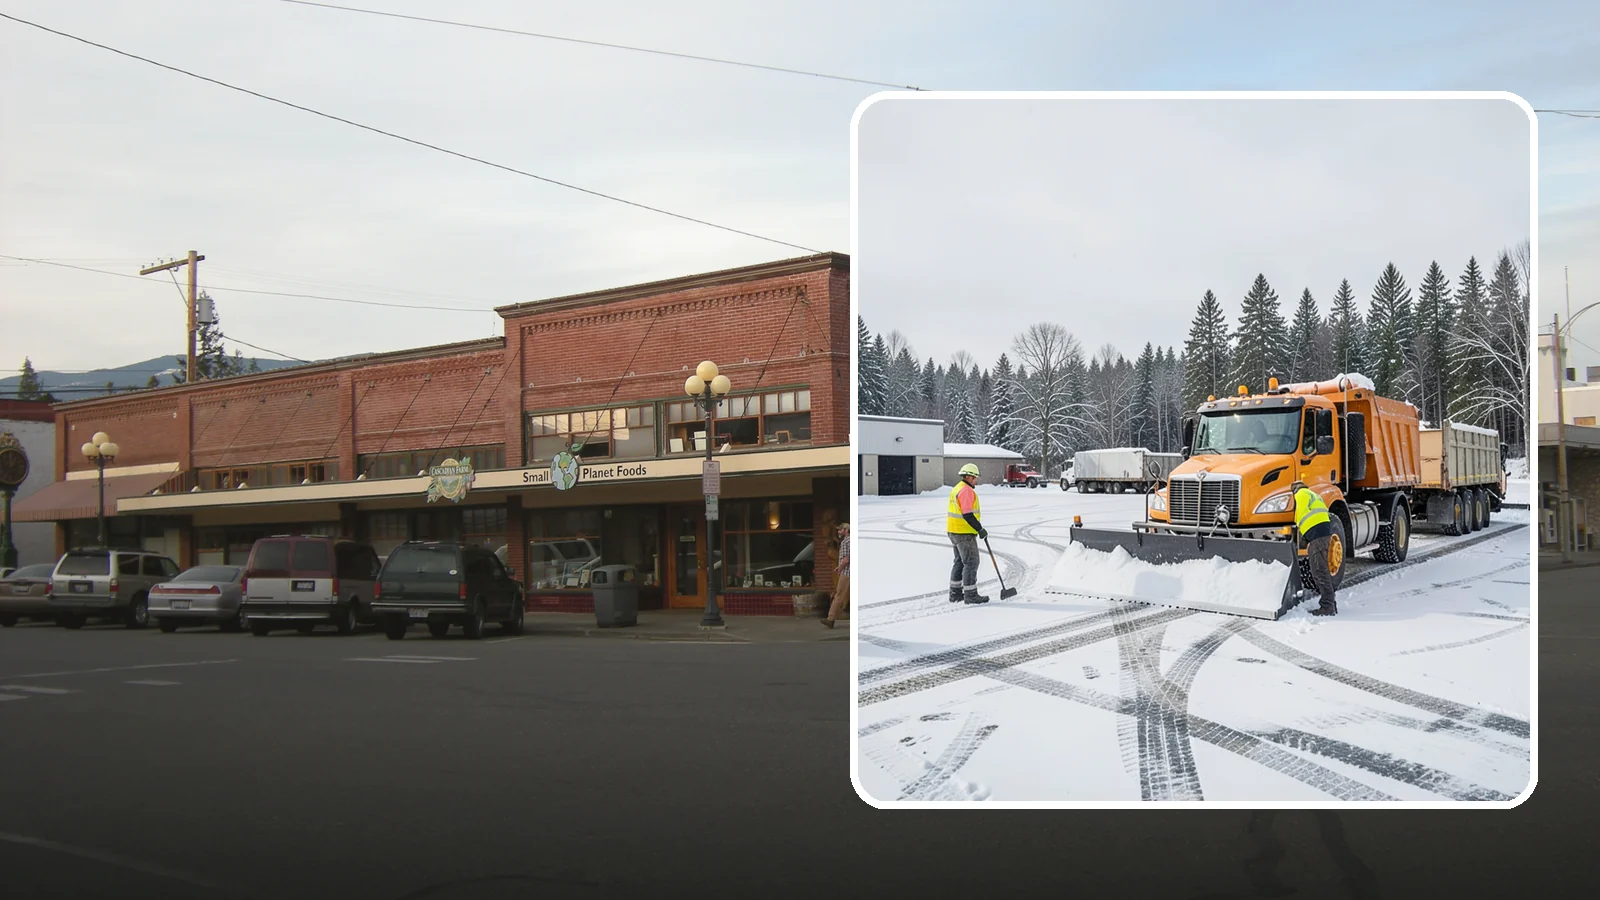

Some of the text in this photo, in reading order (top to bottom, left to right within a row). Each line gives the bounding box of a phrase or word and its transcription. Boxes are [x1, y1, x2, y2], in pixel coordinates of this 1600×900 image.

[456, 465, 469, 474] FARM
[523, 464, 647, 482] Small Planet Foods
